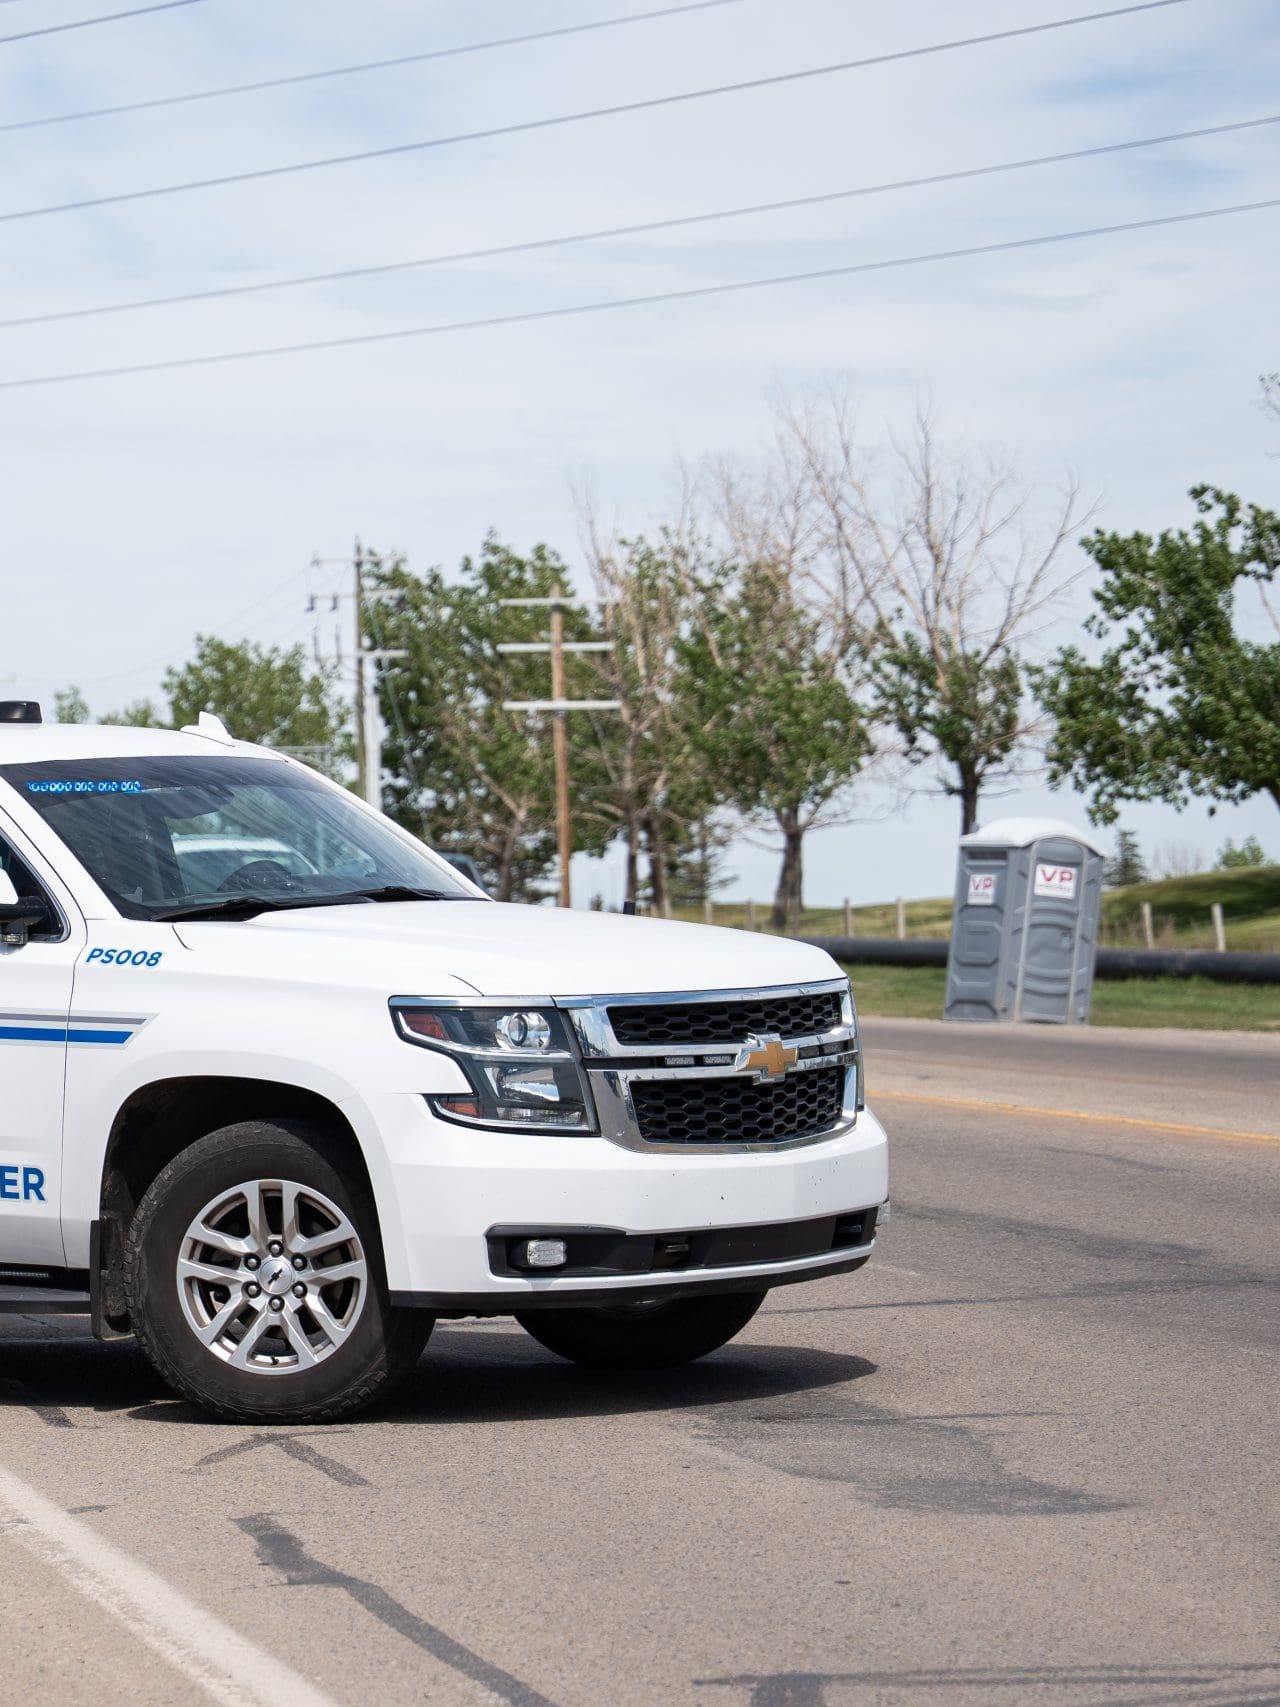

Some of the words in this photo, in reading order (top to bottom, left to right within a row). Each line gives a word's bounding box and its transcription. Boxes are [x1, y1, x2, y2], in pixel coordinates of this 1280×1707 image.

[1040, 868, 1073, 883] VP
[972, 876, 993, 891] VP
[86, 948, 163, 967] PS008
